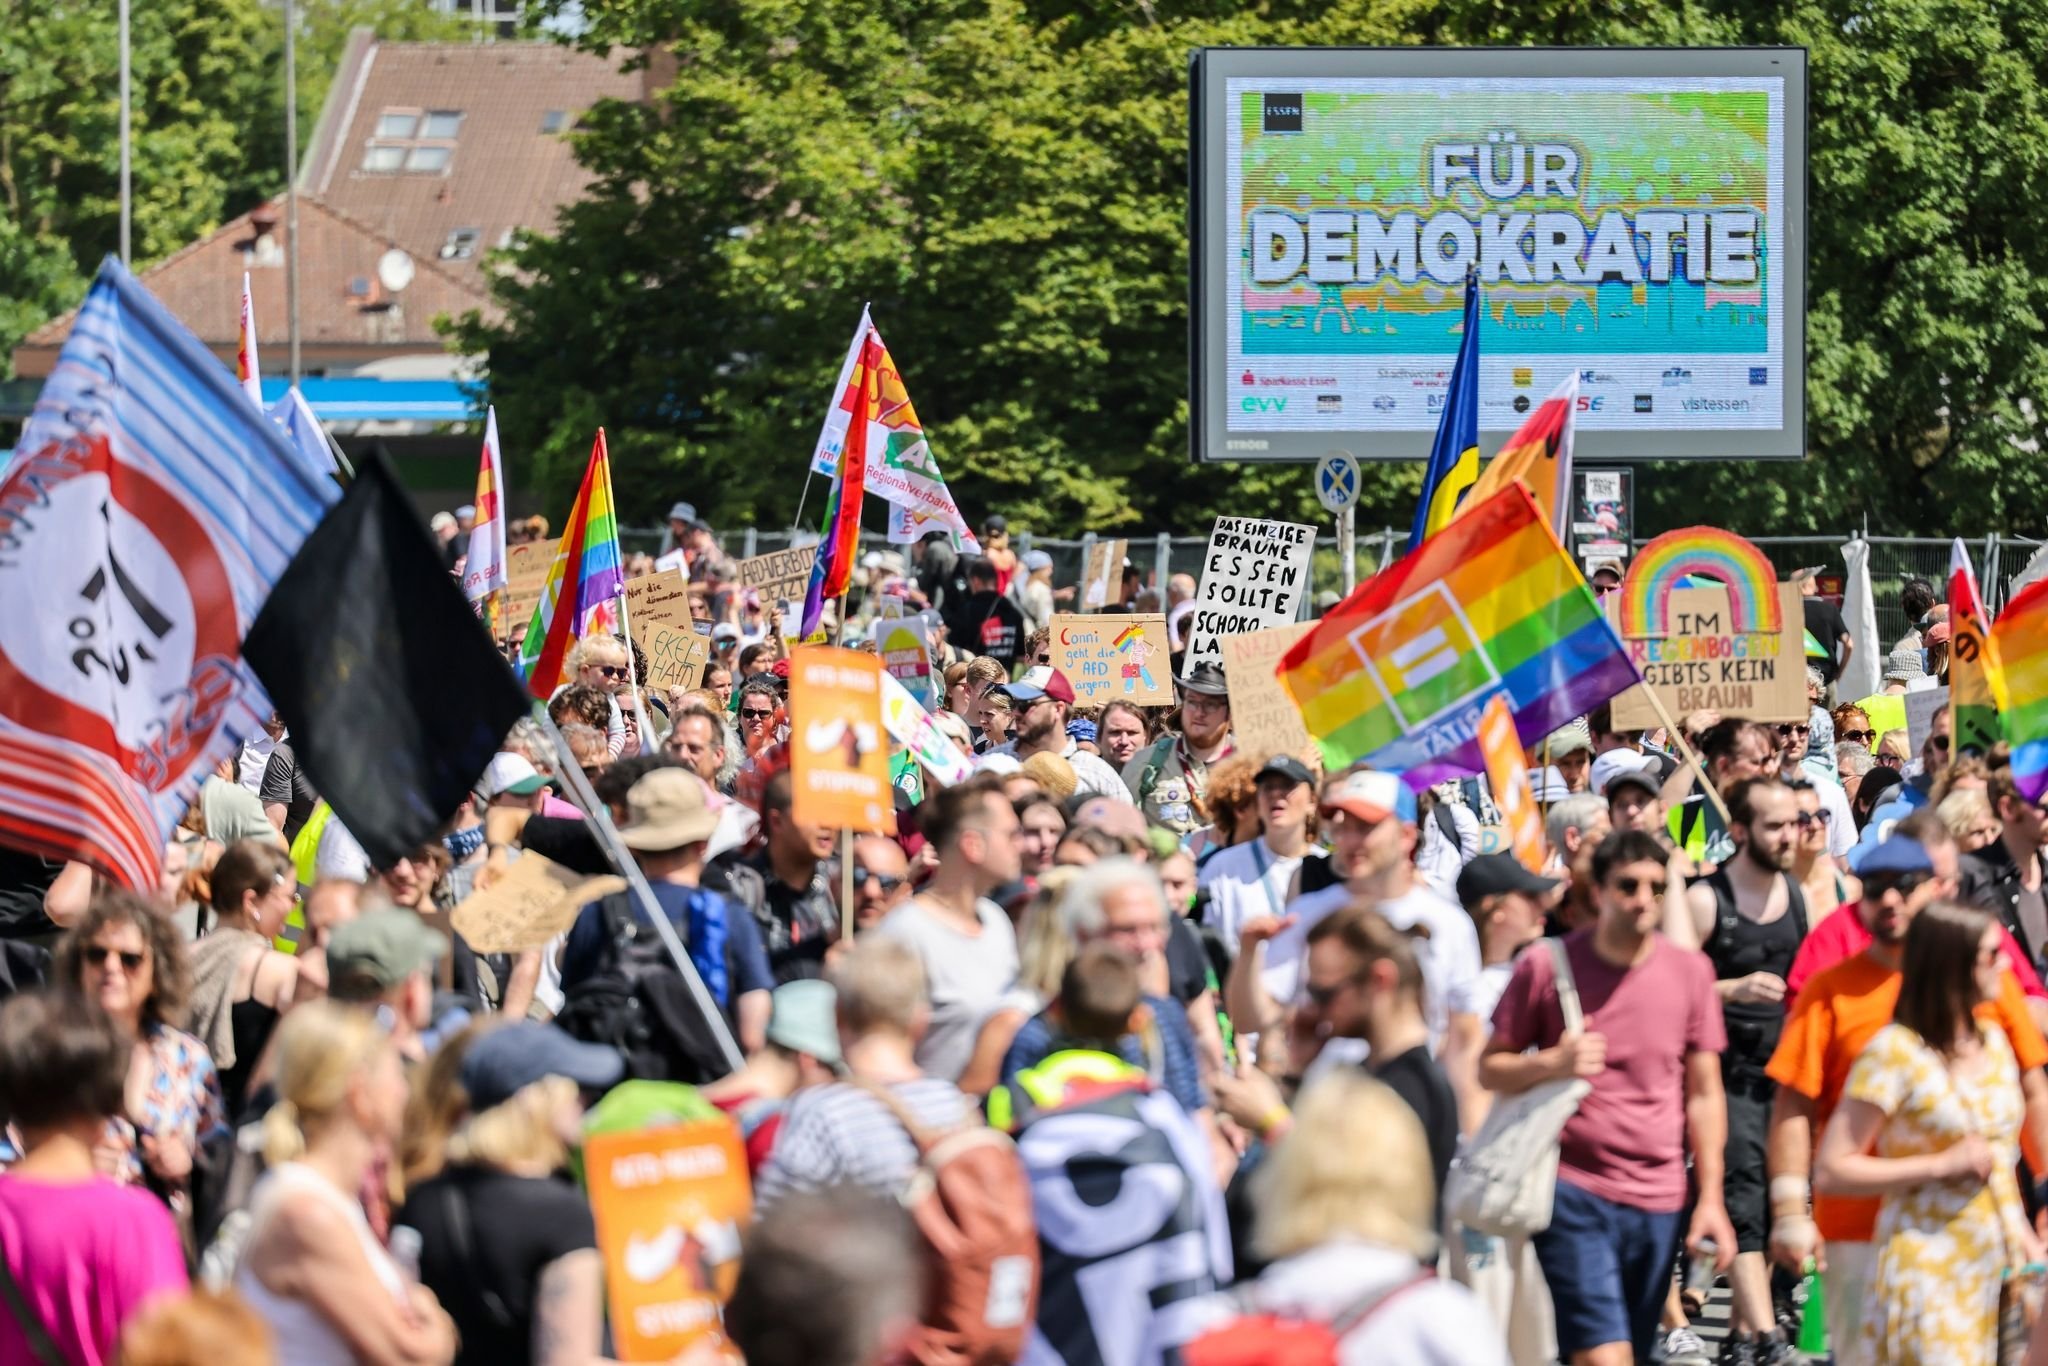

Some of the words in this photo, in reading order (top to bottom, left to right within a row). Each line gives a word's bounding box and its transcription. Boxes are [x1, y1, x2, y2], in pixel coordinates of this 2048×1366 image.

[1432, 130, 1581, 198] FÜR
[1252, 210, 1759, 284] DEMOKRATIE
[1218, 519, 1240, 533] DAS
[1243, 522, 1307, 545] EINZIGE
[1213, 533, 1293, 561] BRAUNE
[1209, 554, 1297, 587] ESSEN
[646, 583, 662, 593] die
[1207, 582, 1290, 615] SOLLTE
[1060, 627, 1100, 646] Conni
[1677, 612, 1720, 636] IM
[655, 630, 697, 668] EKEL
[1066, 648, 1089, 669] geht
[1097, 647, 1115, 658] die
[1630, 634, 1780, 664] REGENBOGEN
[1083, 661, 1108, 676] AfD
[1643, 662, 1711, 686] GIBTS
[1720, 659, 1775, 684] KEIN
[1075, 678, 1111, 697] ärgern
[1677, 685, 1754, 711] BRAUN
